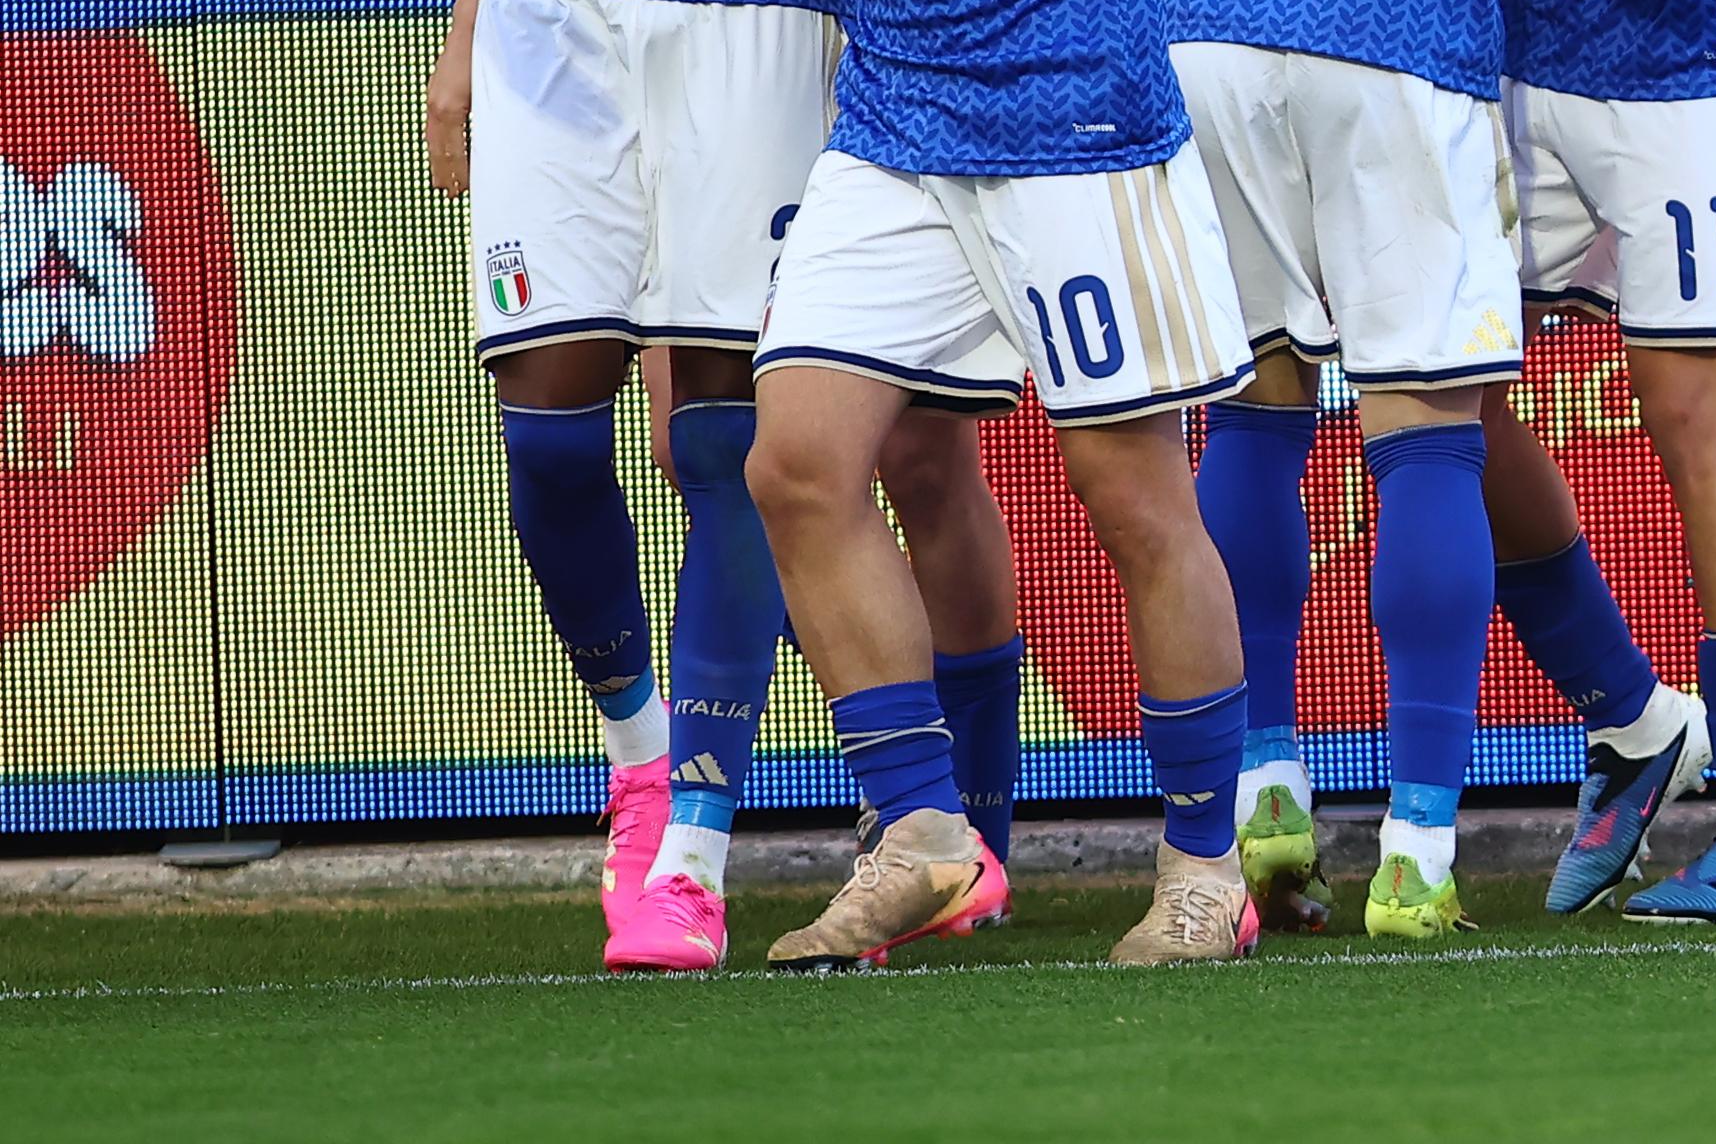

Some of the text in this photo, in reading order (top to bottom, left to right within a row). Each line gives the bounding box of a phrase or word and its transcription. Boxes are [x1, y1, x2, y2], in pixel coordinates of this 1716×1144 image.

[490, 256, 521, 273] ITALIA
[1026, 274, 1124, 388] 10
[674, 698, 751, 722] ITALIA
